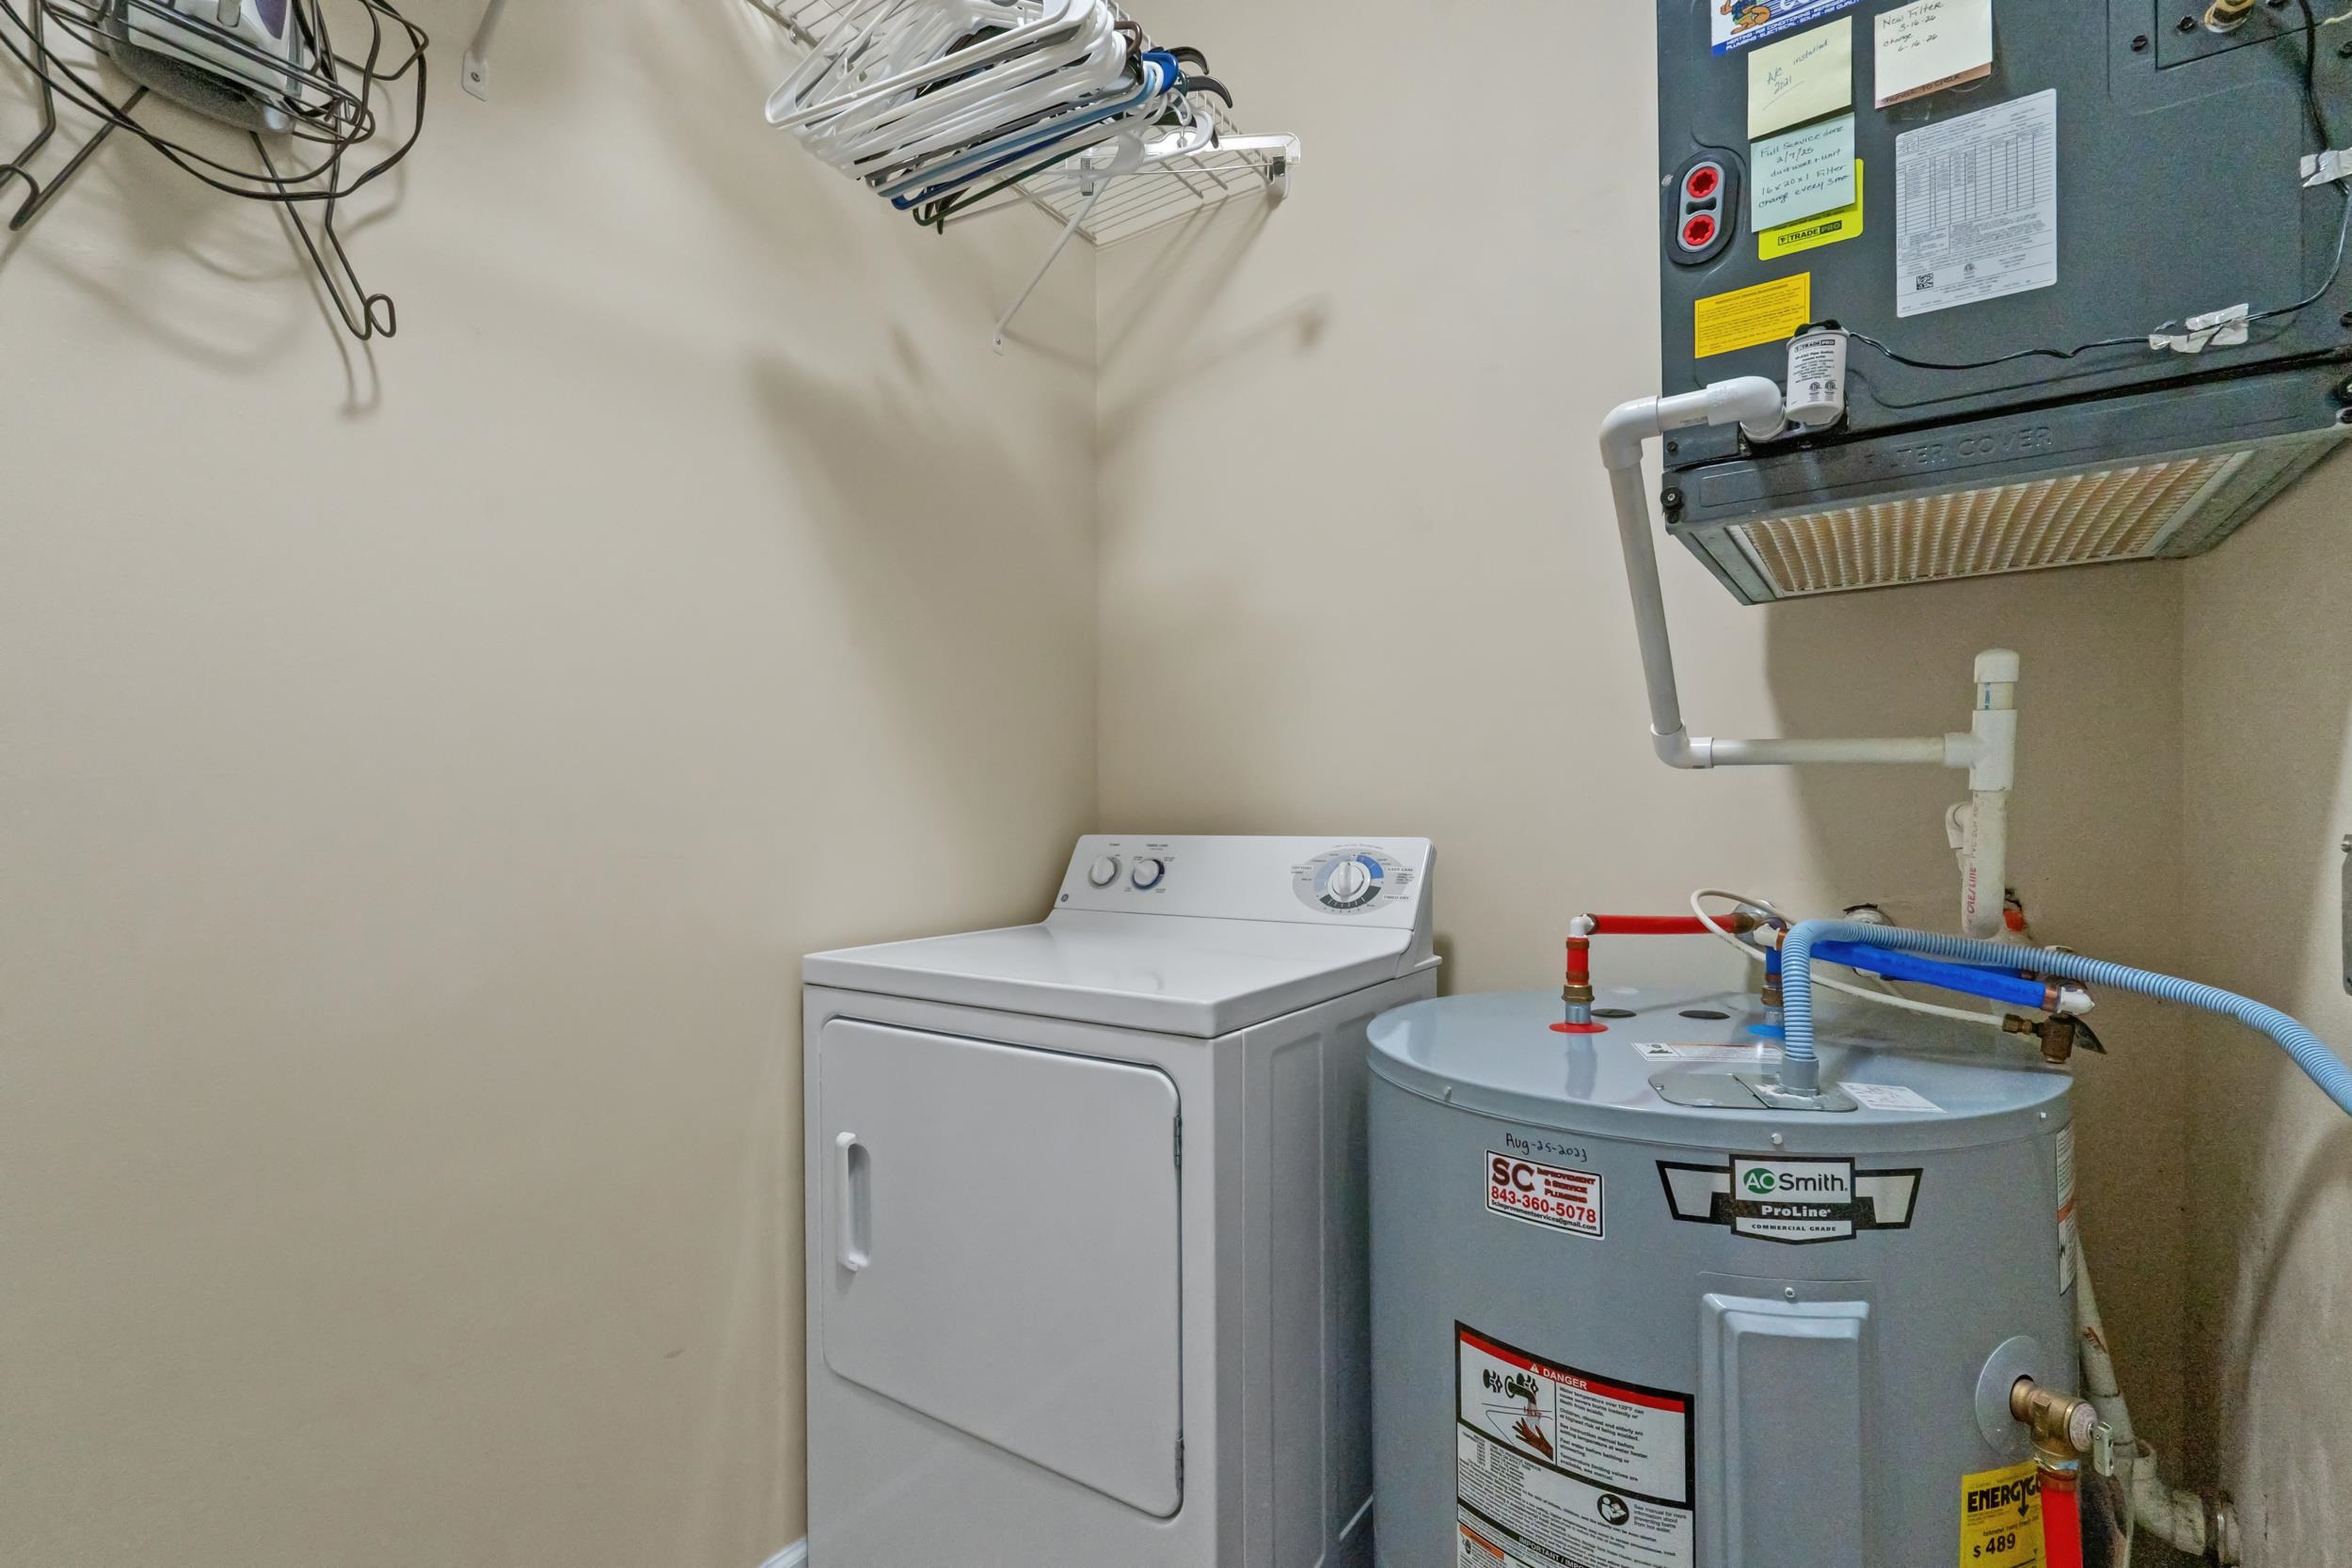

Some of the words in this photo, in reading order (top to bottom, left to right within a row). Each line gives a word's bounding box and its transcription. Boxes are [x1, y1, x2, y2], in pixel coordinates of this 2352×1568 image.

[1726, 36, 1756, 51] PLUMBING
[1760, 22, 1796, 38] ELECTRICAL
[1793, 39, 1828, 65] installed
[1760, 145, 1779, 158] Full
[1958, 426, 2052, 456] COVER
[1491, 1157, 1535, 1193] SC
[1491, 1185, 1597, 1224] 843-360-5078
[1543, 1368, 1587, 1390] DANGER
[1519, 1536, 1560, 1560] IMPORTANT
[1985, 1532, 2016, 1555] 489
